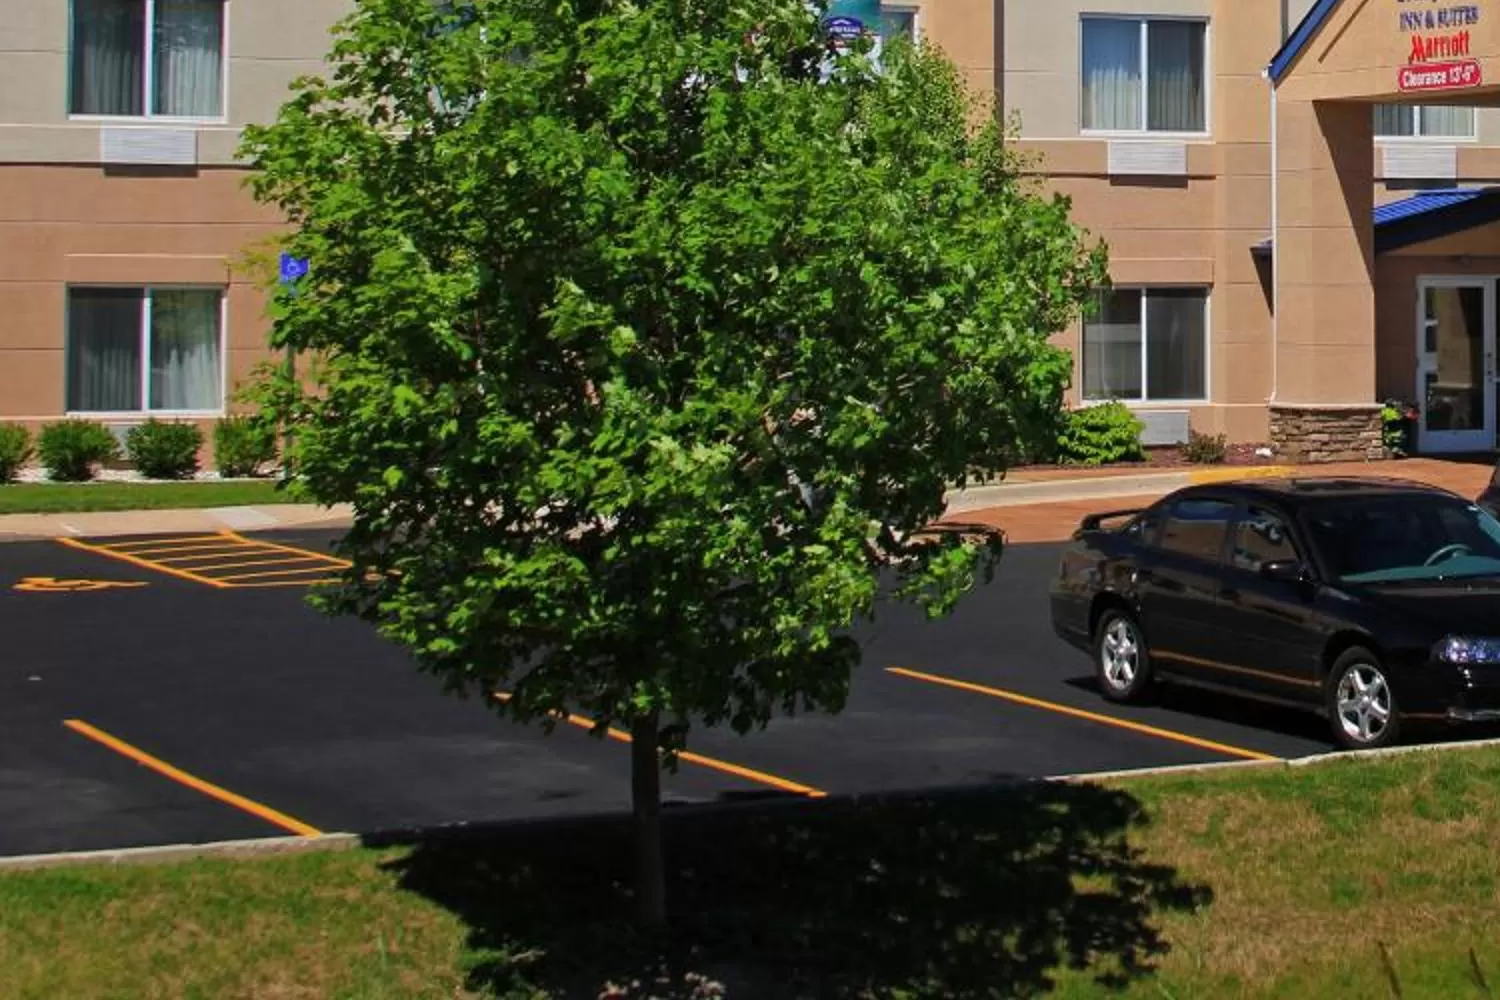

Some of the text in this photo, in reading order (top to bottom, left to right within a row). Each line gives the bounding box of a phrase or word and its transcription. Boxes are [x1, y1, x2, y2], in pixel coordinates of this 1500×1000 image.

[1399, 5, 1478, 32] INN & SUITES
[1408, 29, 1469, 65] Marriott
[1402, 70, 1447, 88] Clearance
